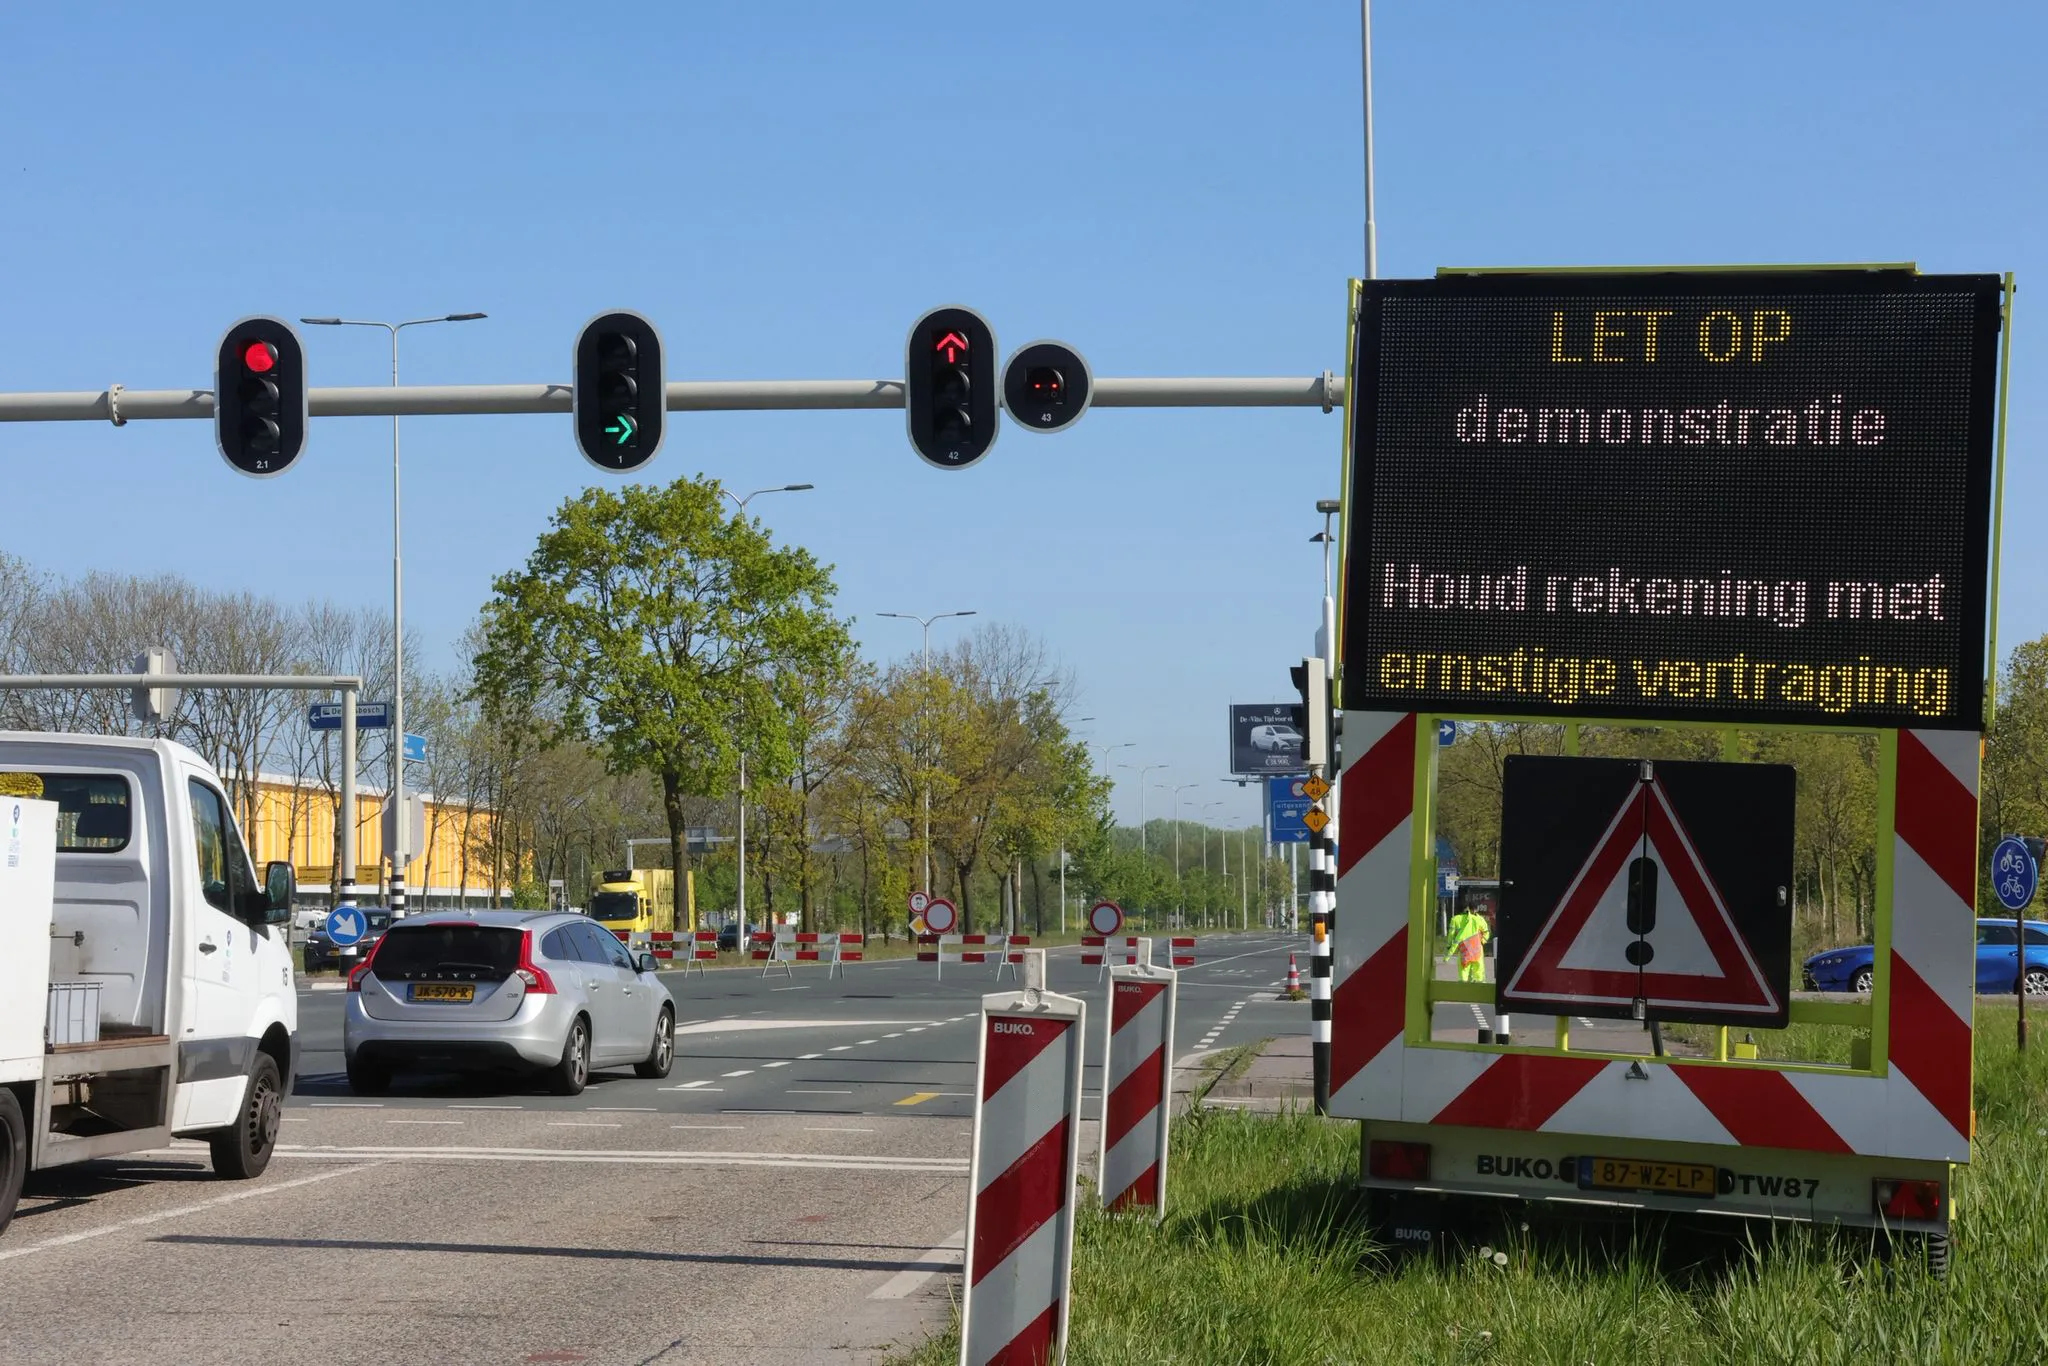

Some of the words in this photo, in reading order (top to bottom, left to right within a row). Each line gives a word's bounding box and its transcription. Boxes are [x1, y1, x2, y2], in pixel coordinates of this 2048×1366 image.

[1551, 311, 1673, 362] LET
[1699, 310, 1791, 362] OP
[1041, 413, 1052, 422] 43
[1456, 393, 1886, 446] demonstratie
[256, 460, 268, 469] 2.1
[618, 455, 623, 464] 1
[948, 452, 959, 460] 42
[1383, 562, 1527, 612] Houd
[1546, 567, 1807, 628] rekening
[1827, 572, 1946, 622] met
[1380, 647, 1617, 704] ernstige
[1632, 653, 1948, 716] vertraging
[1117, 985, 1143, 994] BUKO.
[993, 1022, 1035, 1036] BUKO.
[1476, 1154, 1560, 1180] BUKO.
[1602, 1161, 1705, 1189] 87-WZ-LP
[1737, 1173, 1820, 1200] TW87
[1395, 1227, 1432, 1241] BUKO
